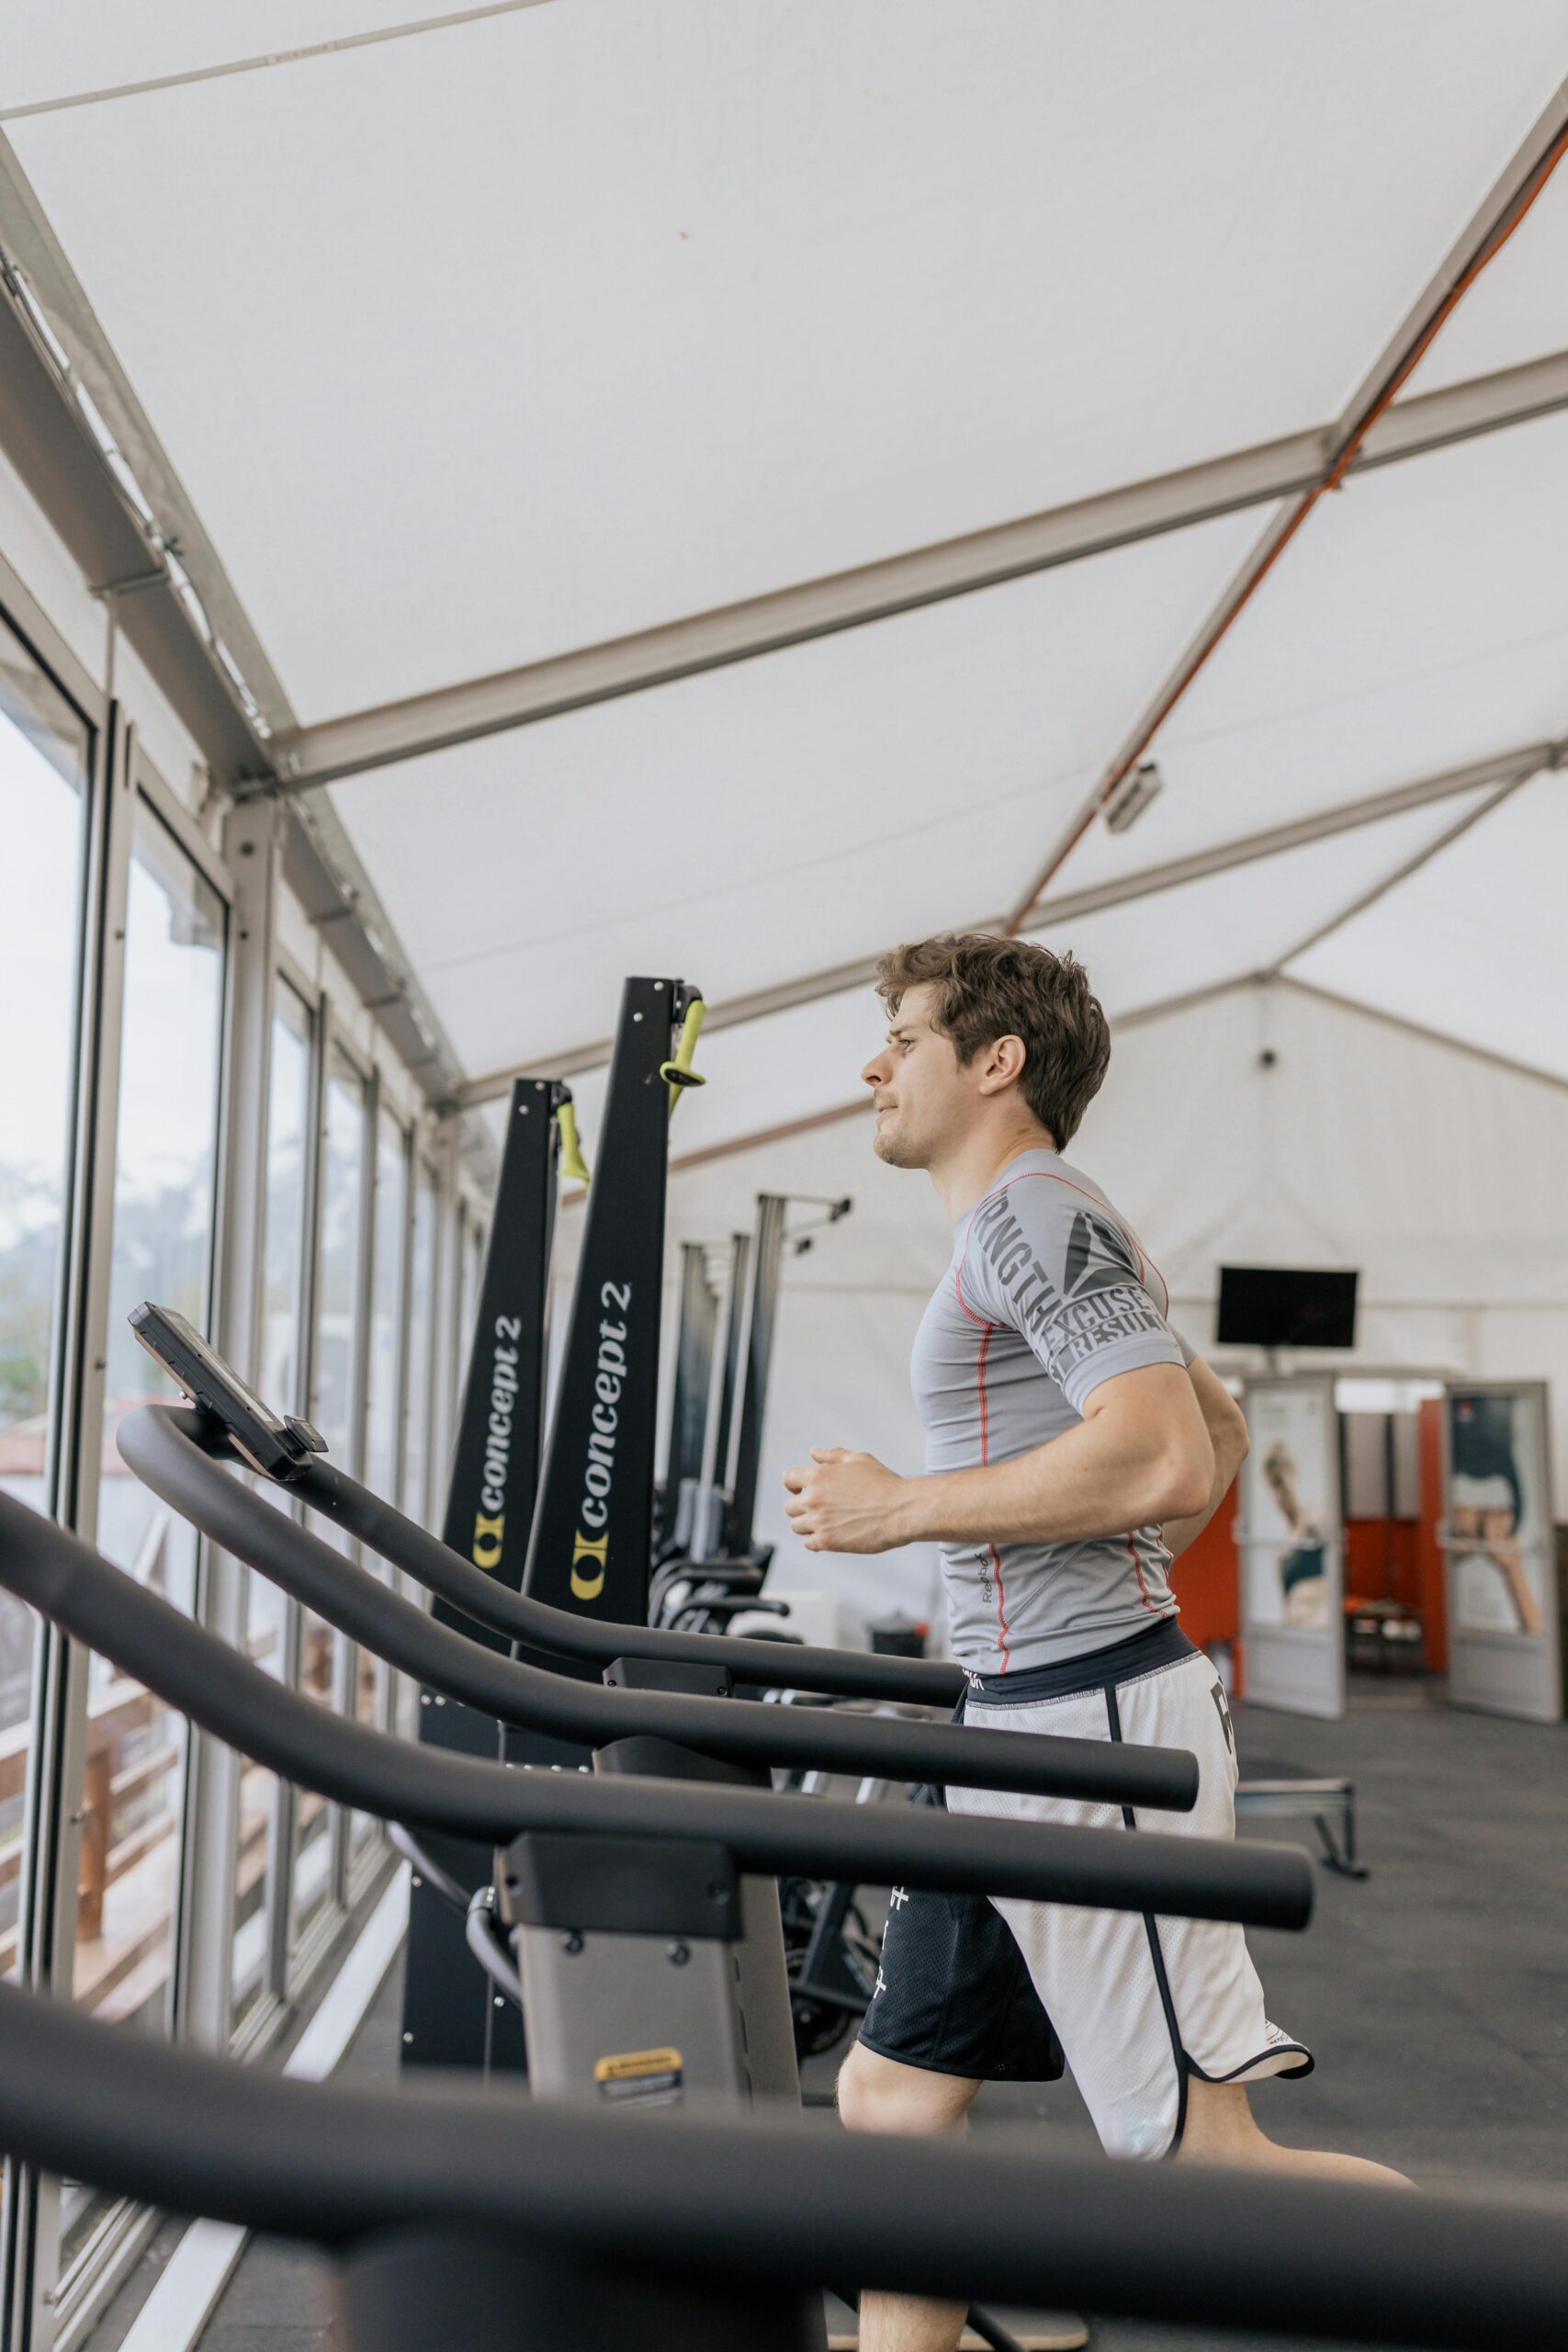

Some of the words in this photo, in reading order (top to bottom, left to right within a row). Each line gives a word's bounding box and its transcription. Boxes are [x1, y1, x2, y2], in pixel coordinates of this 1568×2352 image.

[494, 1315, 522, 1341] 2
[601, 1281, 633, 1312] 2
[974, 1188, 1063, 1334] RNGTH
[480, 1345, 520, 1512] concept
[582, 1319, 627, 1529] concept
